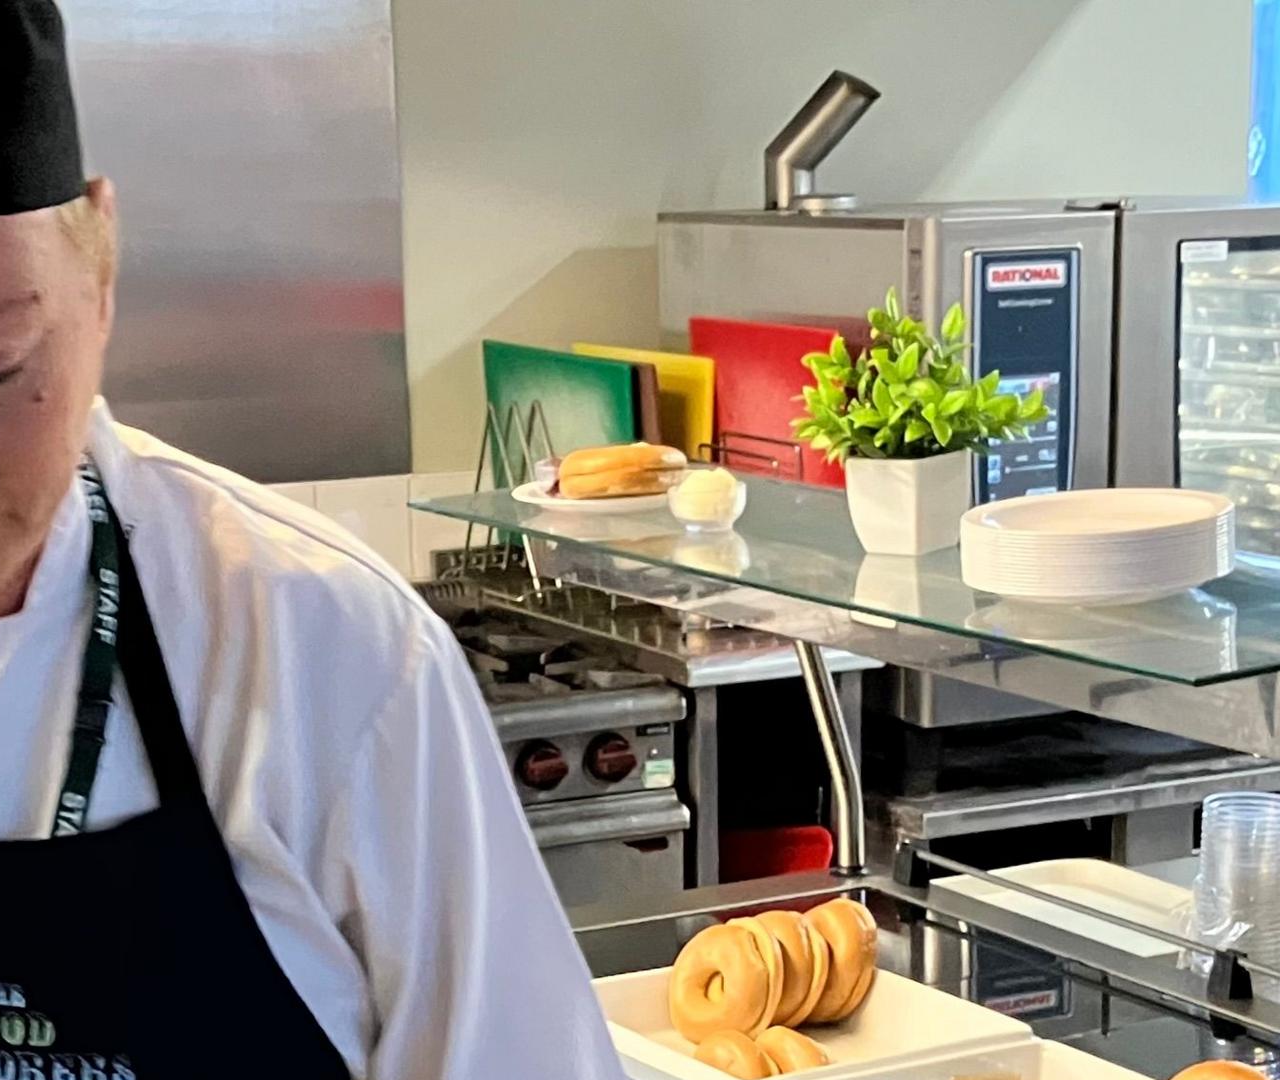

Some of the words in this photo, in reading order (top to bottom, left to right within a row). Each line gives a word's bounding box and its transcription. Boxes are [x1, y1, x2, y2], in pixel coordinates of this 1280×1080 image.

[991, 267, 1060, 283] RATIONAL
[93, 568, 119, 647] STAFF
[53, 791, 87, 838] STA
